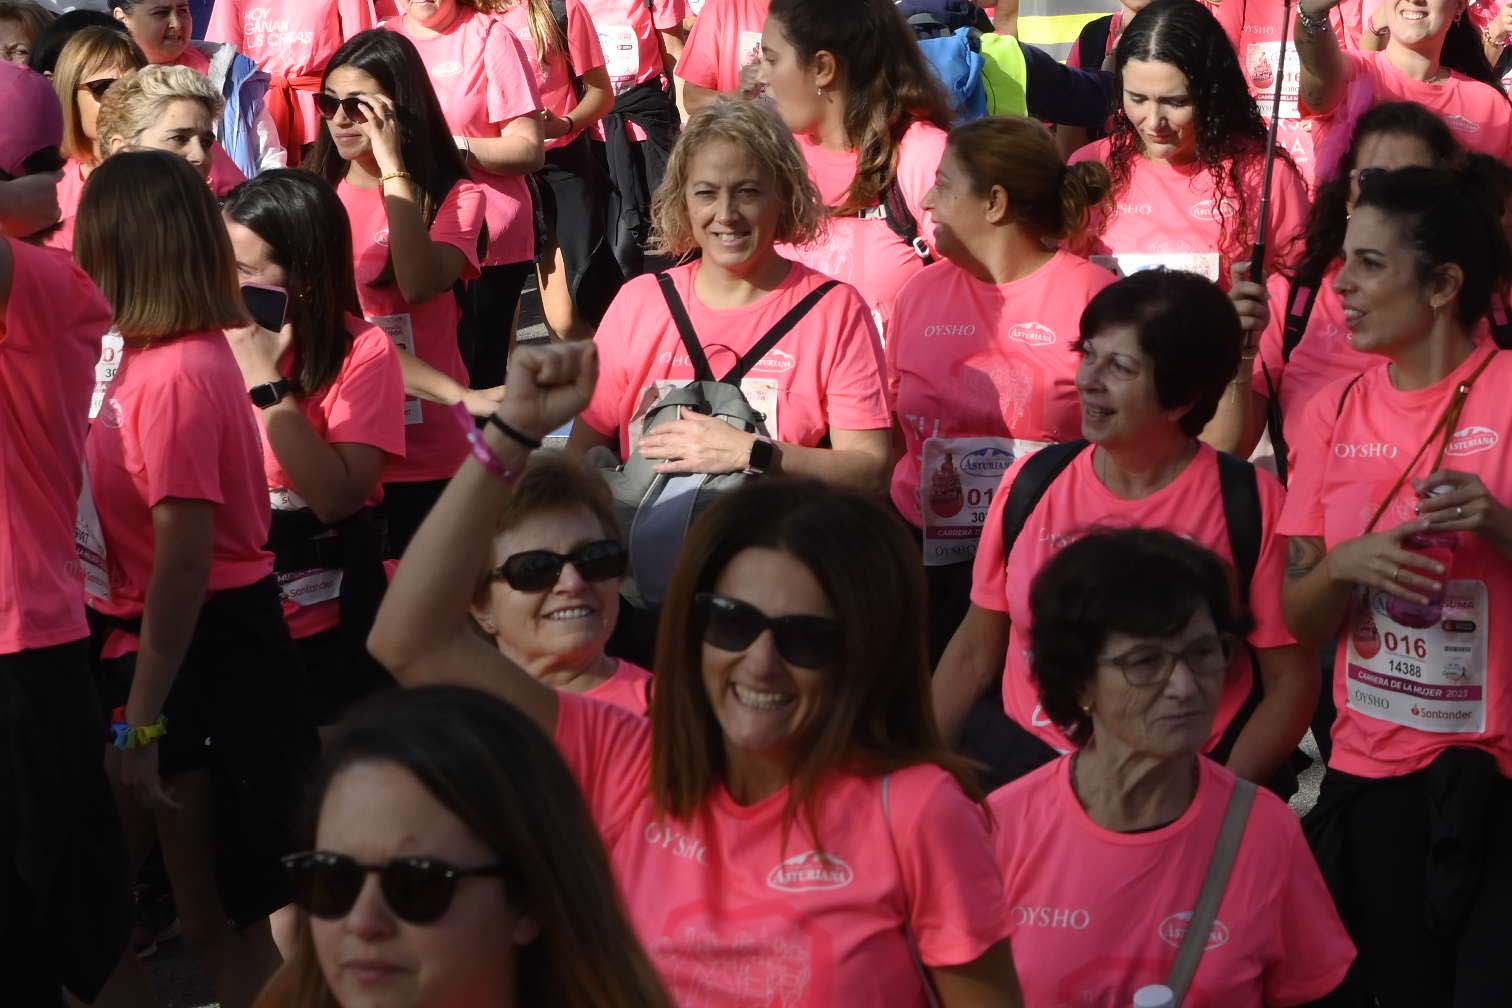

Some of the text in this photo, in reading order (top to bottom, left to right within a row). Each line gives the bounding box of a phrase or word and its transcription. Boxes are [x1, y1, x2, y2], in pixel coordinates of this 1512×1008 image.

[923, 323, 976, 338] OYSHO
[1011, 330, 1053, 345] ASTURIANA
[1334, 442, 1398, 460] OYSHO
[967, 488, 993, 506] 01
[971, 512, 984, 523] 30
[1384, 631, 1427, 658] 016
[1388, 659, 1423, 679] 14388
[1358, 670, 1469, 699] CARRERA DE LA MUJER 2023
[1354, 689, 1391, 710] OYSHO
[1420, 707, 1473, 721] Santander
[775, 868, 847, 884] ASTURIANA
[1010, 905, 1091, 931] OYSHO
